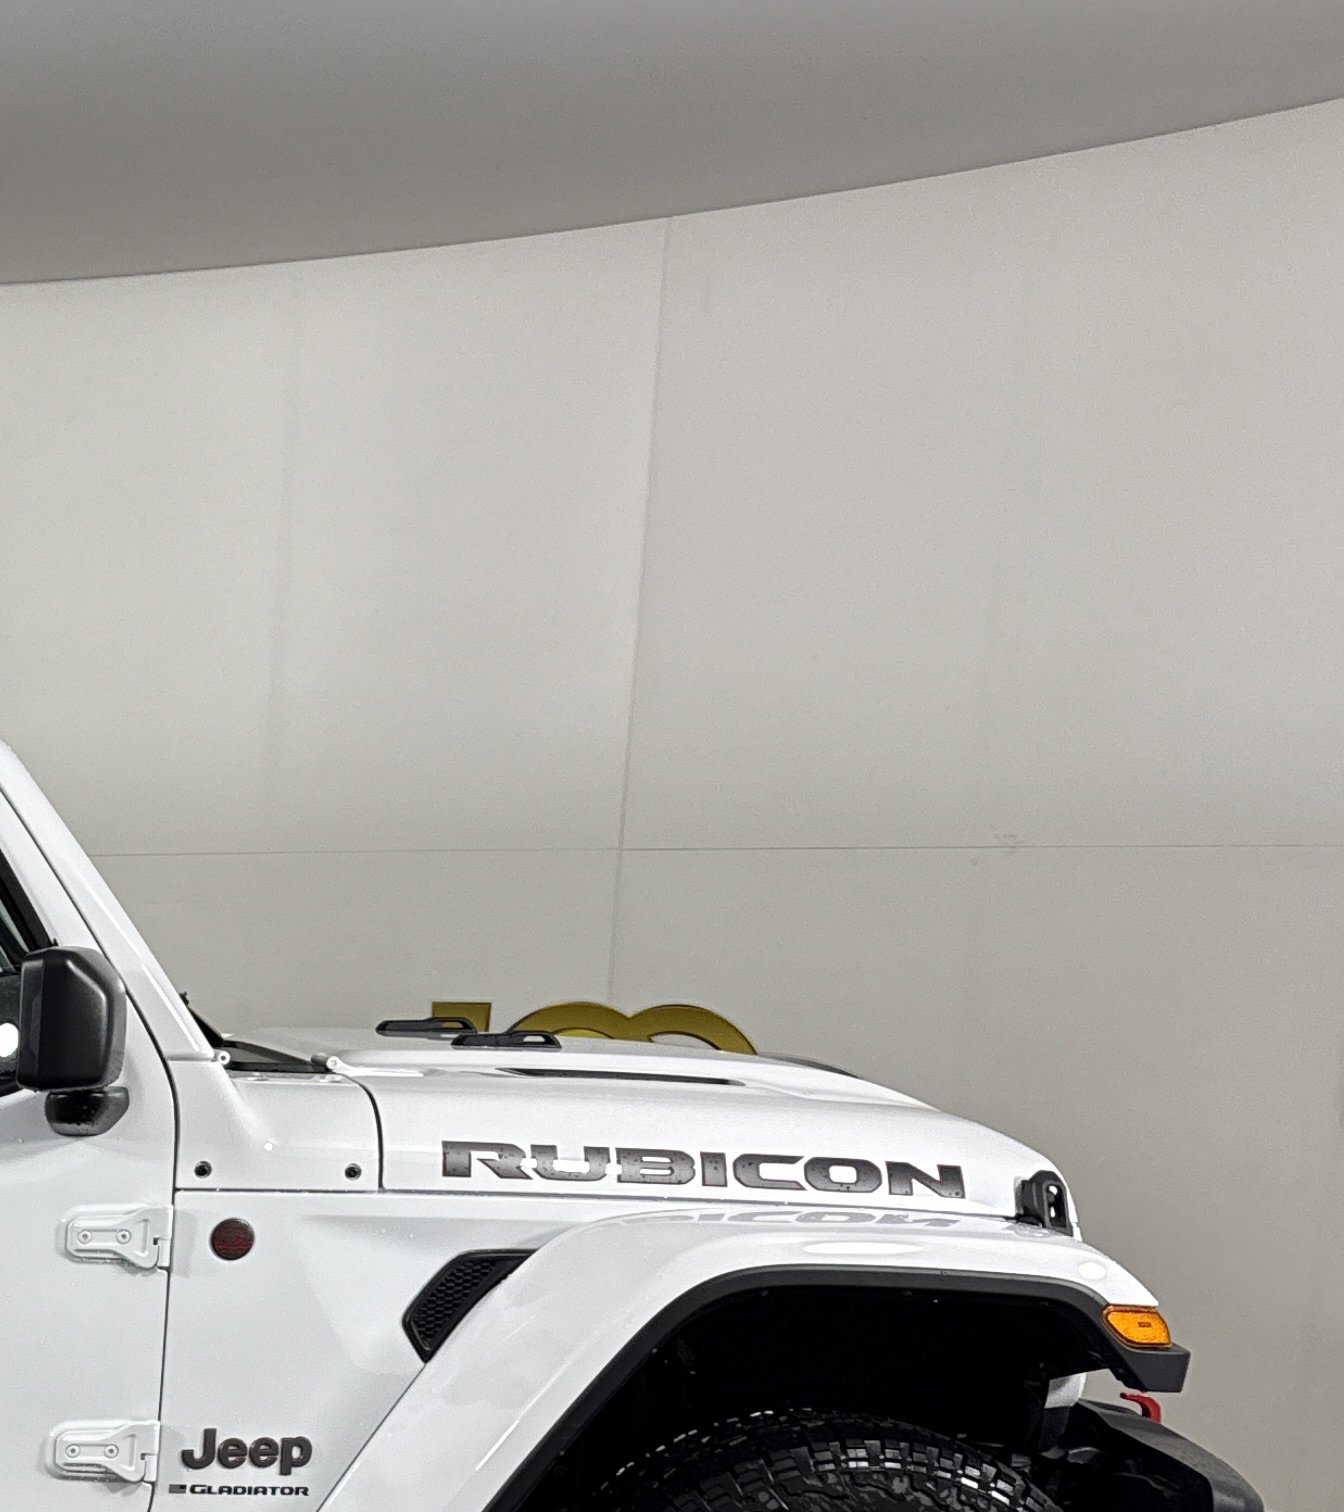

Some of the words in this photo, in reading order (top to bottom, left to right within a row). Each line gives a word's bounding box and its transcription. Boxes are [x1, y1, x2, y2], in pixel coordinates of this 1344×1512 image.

[441, 1140, 965, 1199] RUBICON
[181, 1428, 312, 1475] Jeep
[190, 1484, 310, 1496] GLADIATOR
